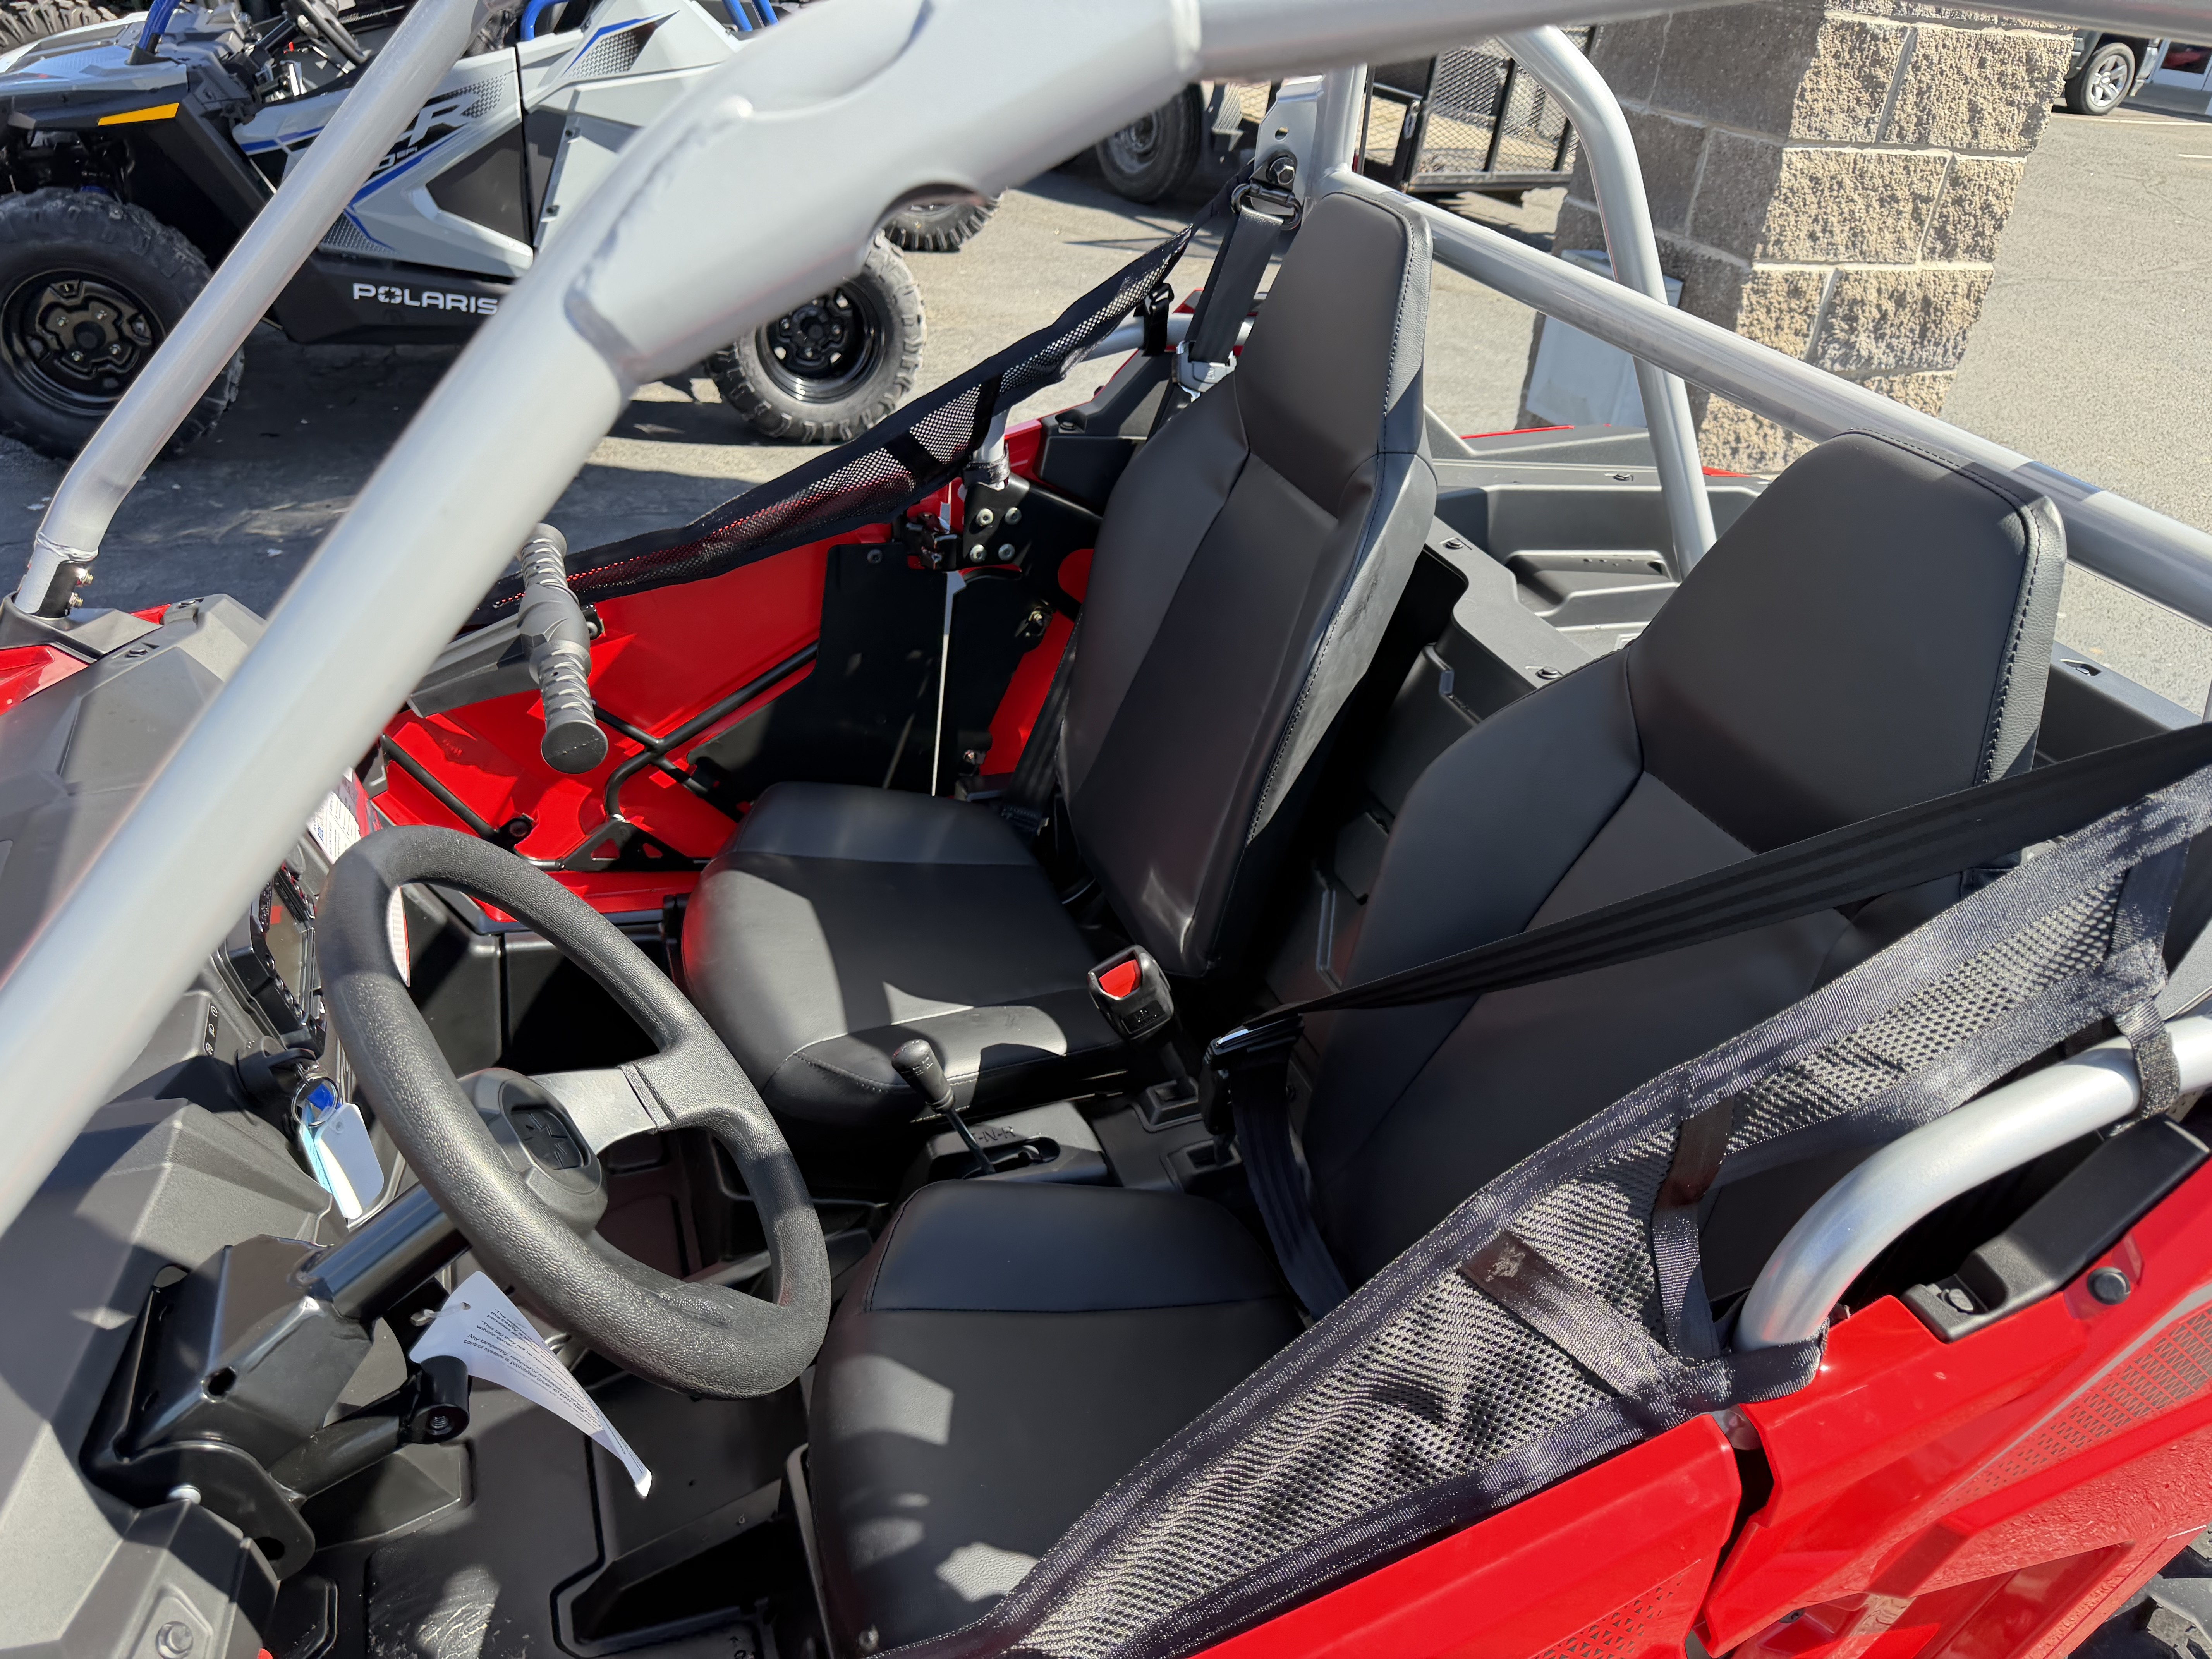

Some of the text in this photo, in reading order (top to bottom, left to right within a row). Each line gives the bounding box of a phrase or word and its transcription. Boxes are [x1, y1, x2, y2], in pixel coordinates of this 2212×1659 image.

[353, 282, 499, 315] POLARIS
[477, 1325, 496, 1337] vehicle
[504, 1336, 516, 1345] may
[463, 1339, 484, 1349] control
[484, 1347, 504, 1358] system
[510, 1361, 536, 1378] prohibited
[537, 1378, 551, 1388] under
[510, 1355, 532, 1370] removal
